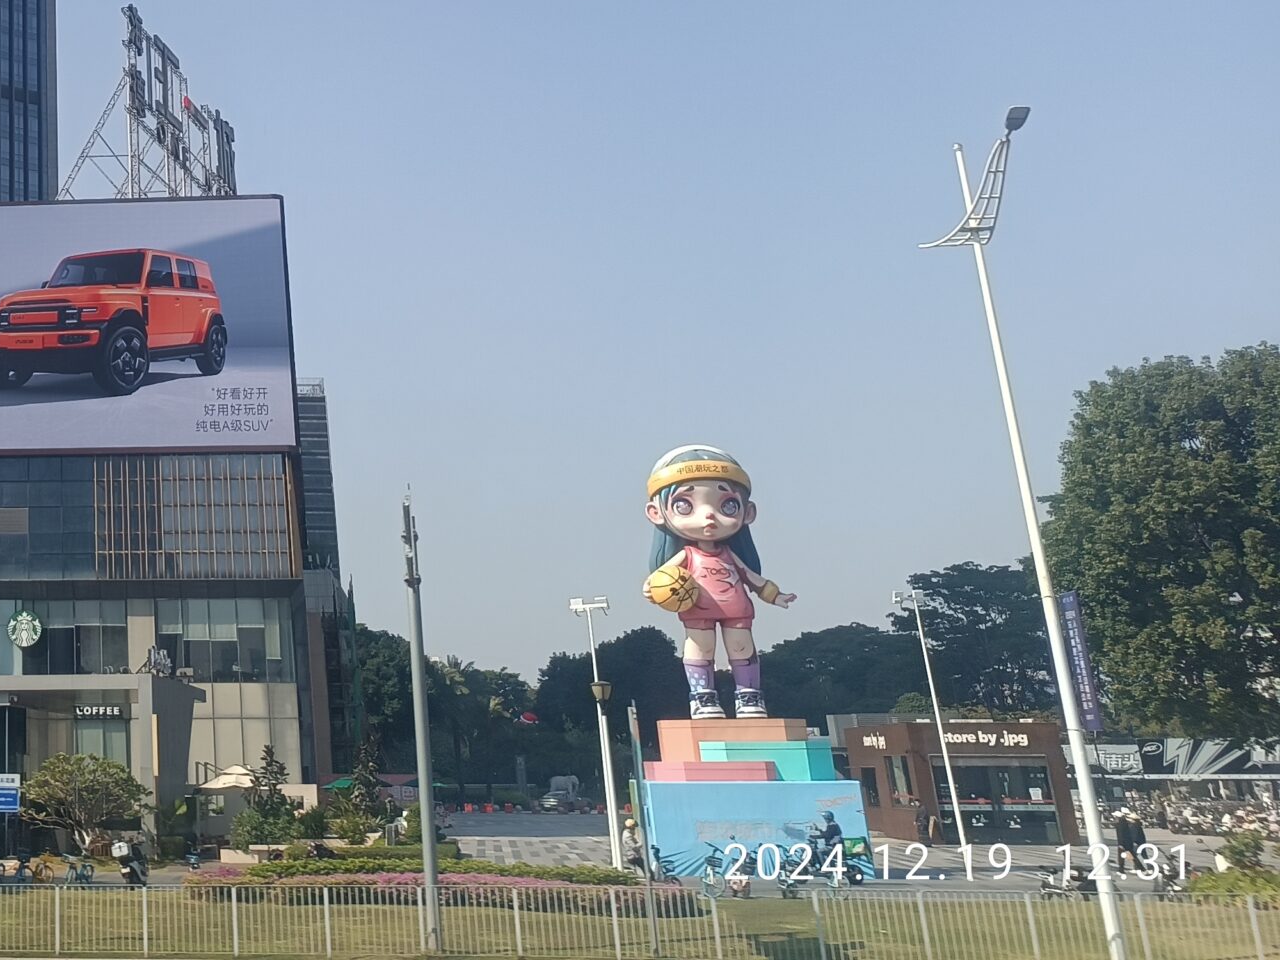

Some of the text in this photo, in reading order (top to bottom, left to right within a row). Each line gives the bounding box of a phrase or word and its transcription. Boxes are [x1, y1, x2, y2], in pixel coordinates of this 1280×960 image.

[204, 403, 269, 416] 好用好玩的
[76, 706, 120, 715] COFFEE
[978, 730, 997, 746] by
[1000, 730, 1029, 747] .jpg
